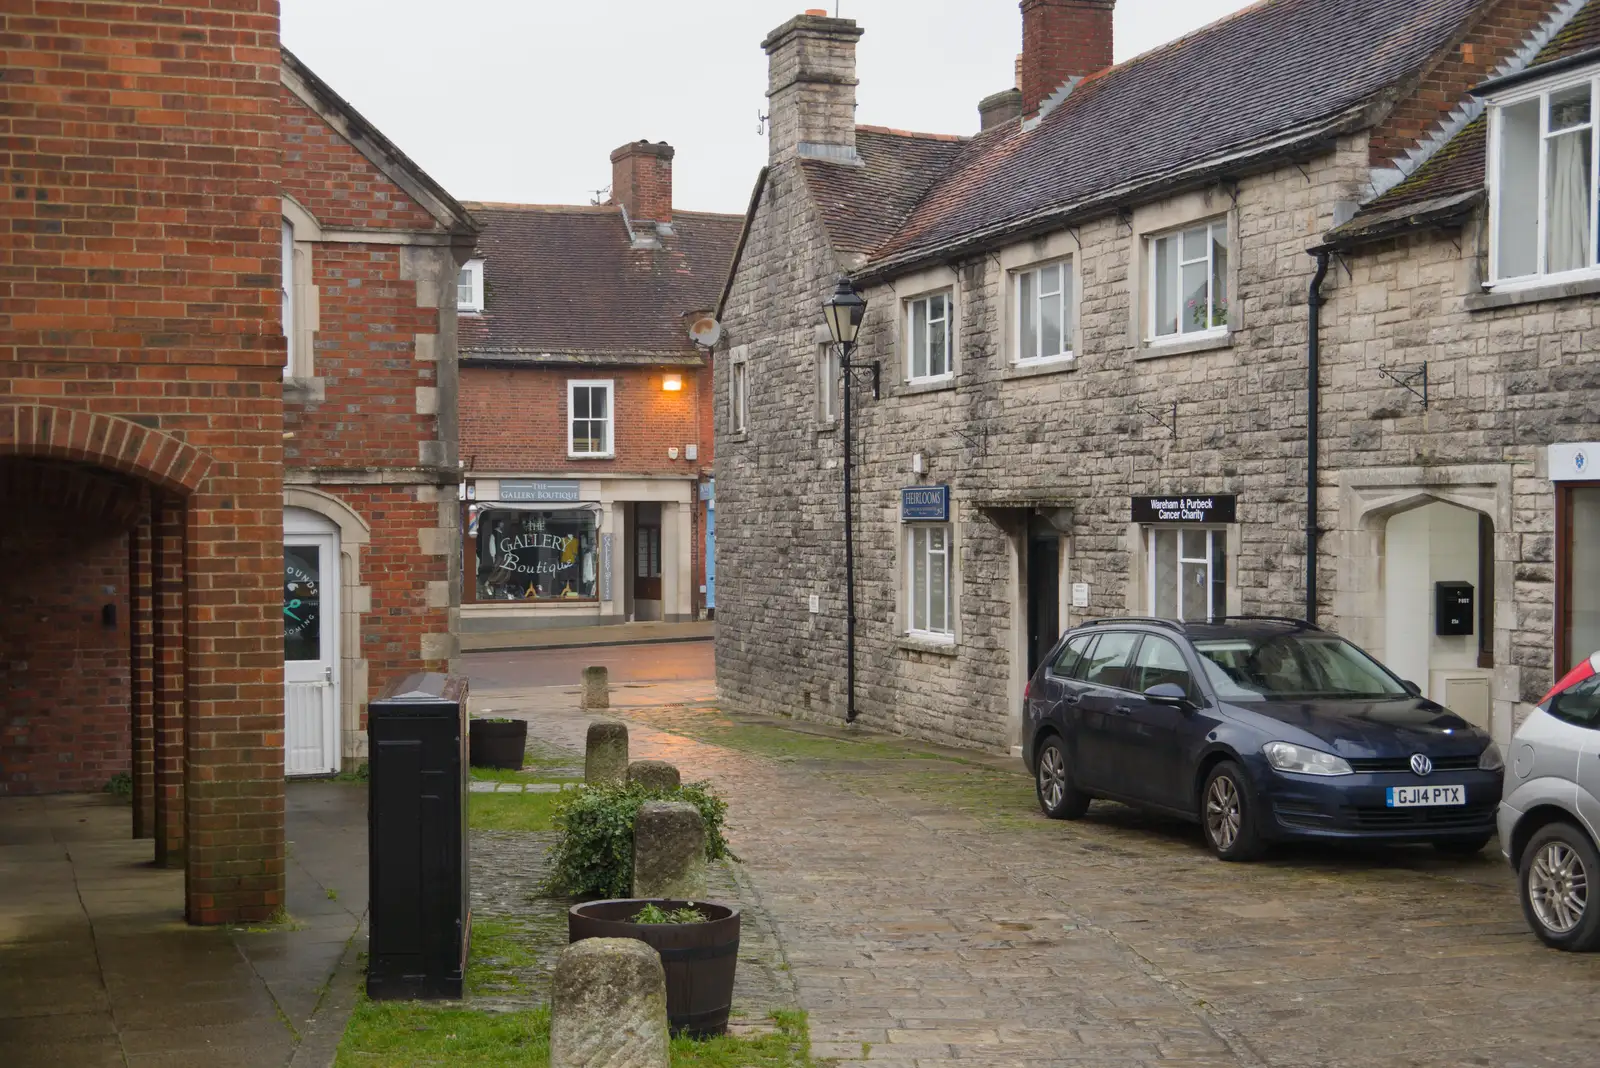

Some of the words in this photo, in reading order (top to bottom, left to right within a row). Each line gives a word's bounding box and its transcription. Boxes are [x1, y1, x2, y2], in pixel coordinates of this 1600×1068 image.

[501, 491, 536, 499] GALLERY
[537, 490, 578, 500] BOUTIQUE
[905, 492, 940, 505] HEIRLOOMS
[1151, 499, 1178, 509] Wareham
[1180, 499, 1185, 509] &
[1187, 499, 1212, 509] Purbeck
[1159, 510, 1180, 520] Cancer
[1181, 509, 1204, 521] Charity
[527, 520, 545, 531] THE
[500, 533, 573, 553] GALLERY
[499, 551, 573, 579] Boutique
[286, 566, 317, 595] OUNDS
[1398, 789, 1430, 804] GJ14
[1433, 788, 1459, 802] PTX
